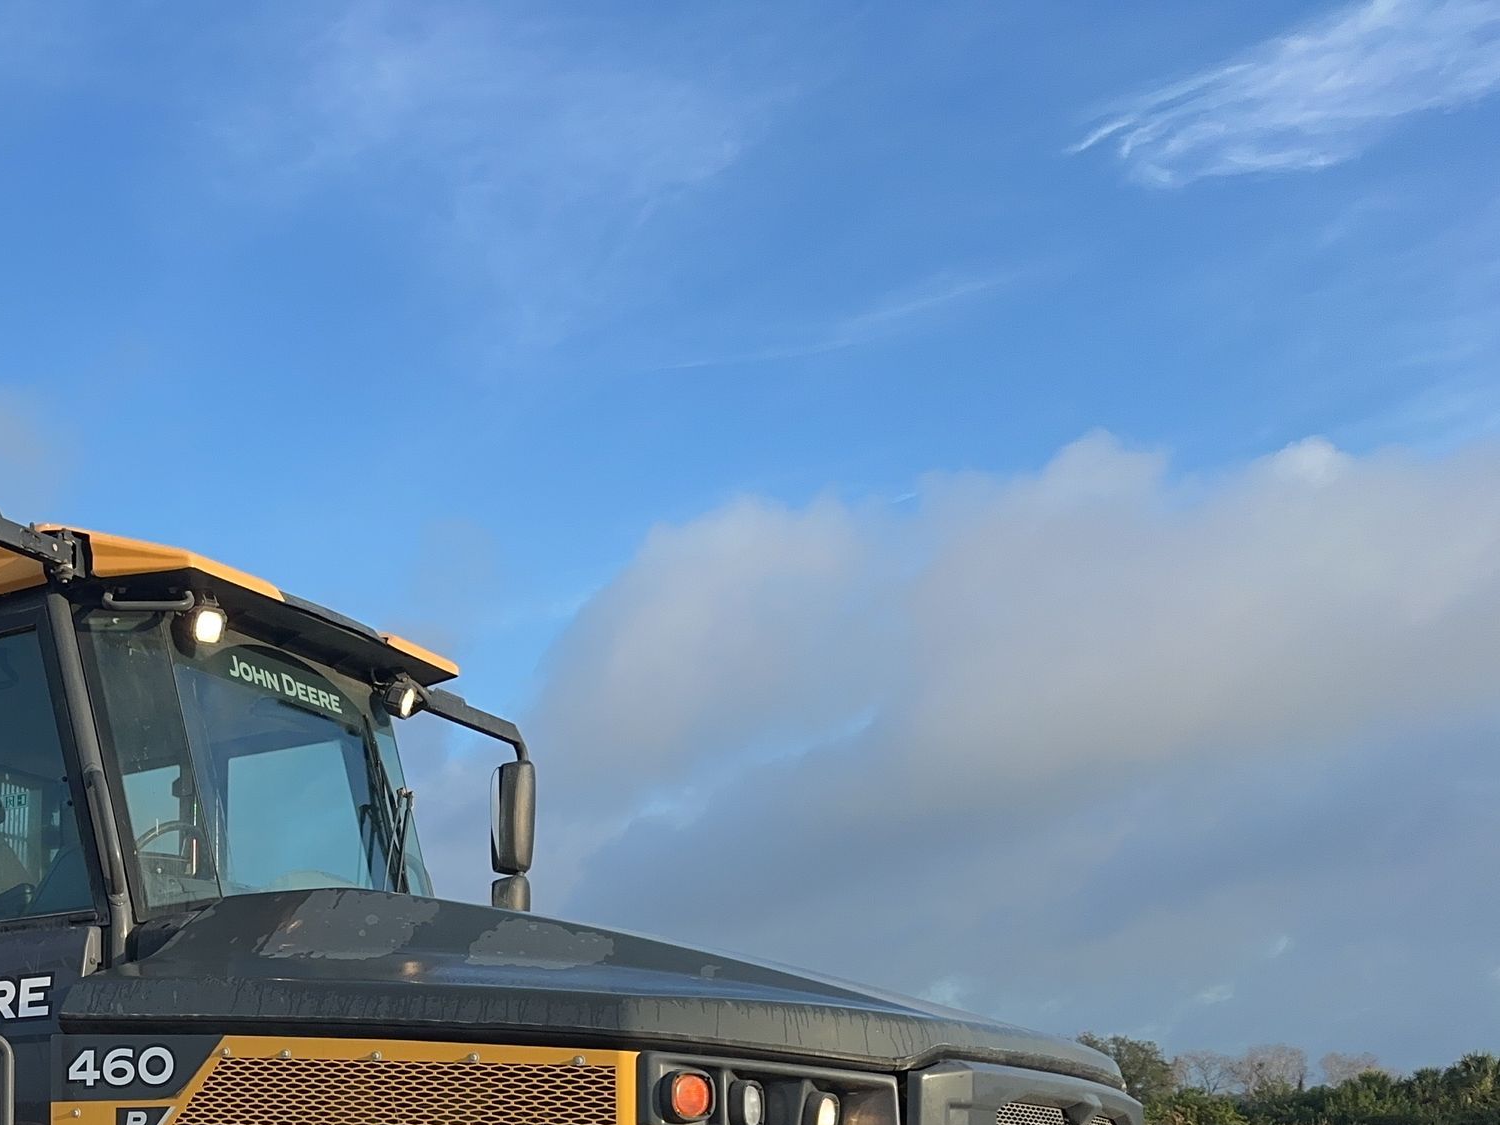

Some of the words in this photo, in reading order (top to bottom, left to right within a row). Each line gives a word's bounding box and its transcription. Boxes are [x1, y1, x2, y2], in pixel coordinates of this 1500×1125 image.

[229, 655, 280, 692] JOHN
[281, 672, 342, 714] DEERE
[68, 1046, 175, 1087] 460
